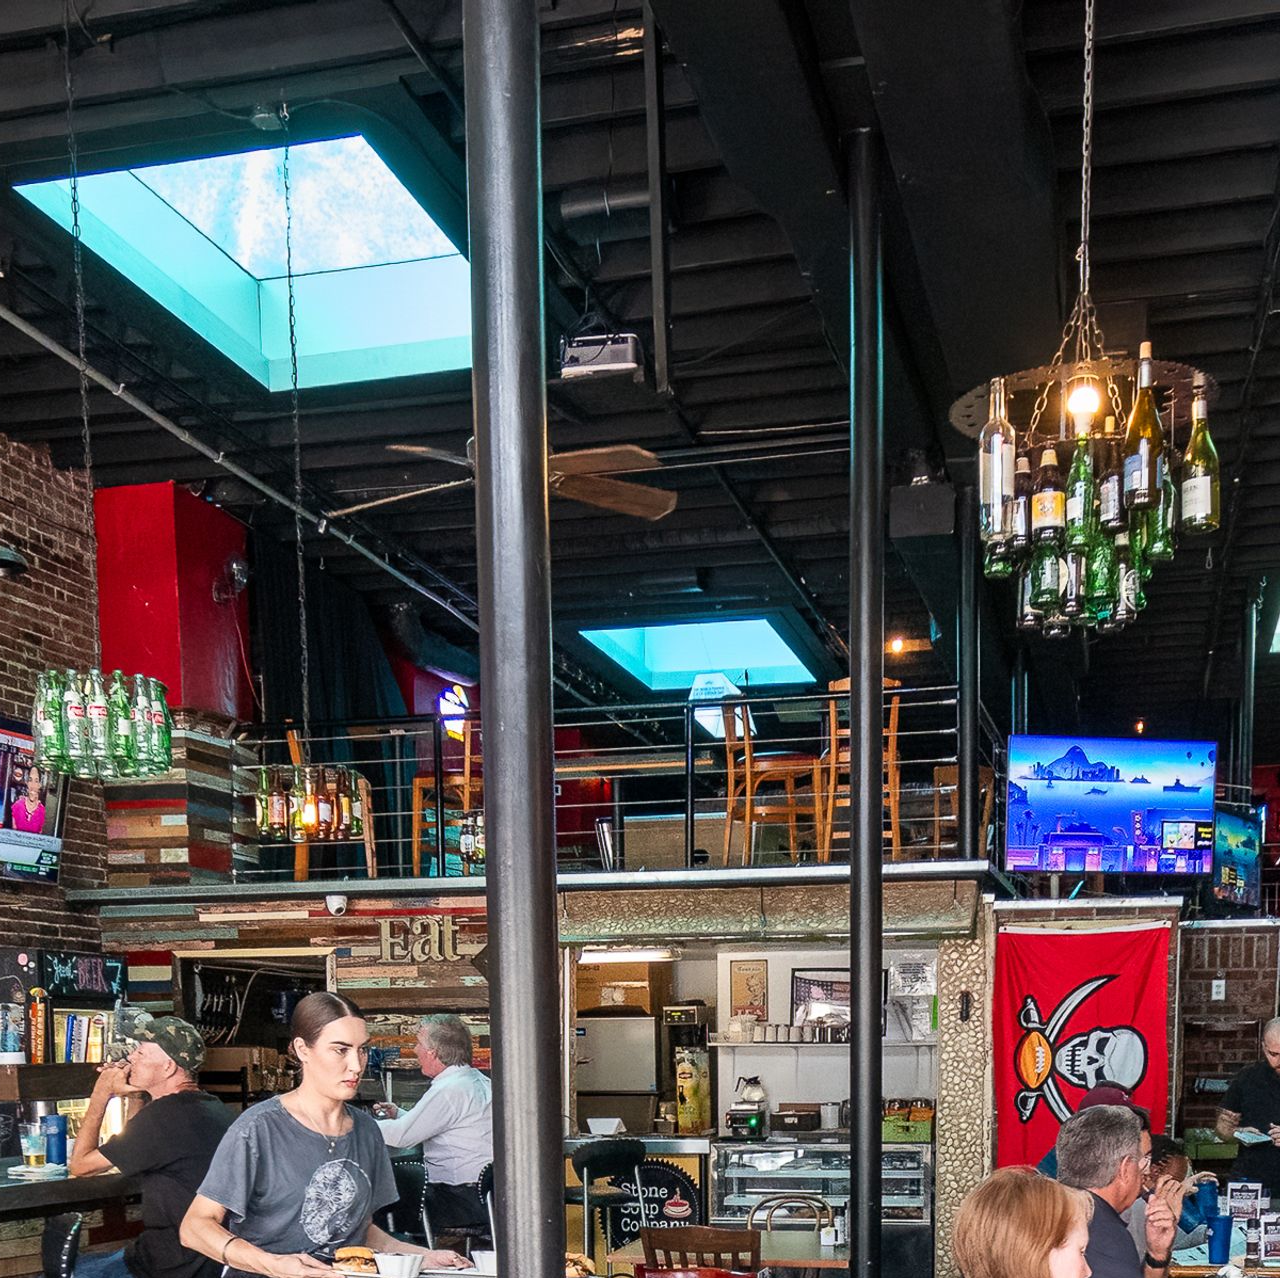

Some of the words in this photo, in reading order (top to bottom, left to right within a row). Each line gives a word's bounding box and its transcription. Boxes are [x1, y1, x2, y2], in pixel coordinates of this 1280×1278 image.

[373, 915, 462, 963] Eat
[76, 956, 109, 993] BEER
[621, 1182, 669, 1199] Stone
